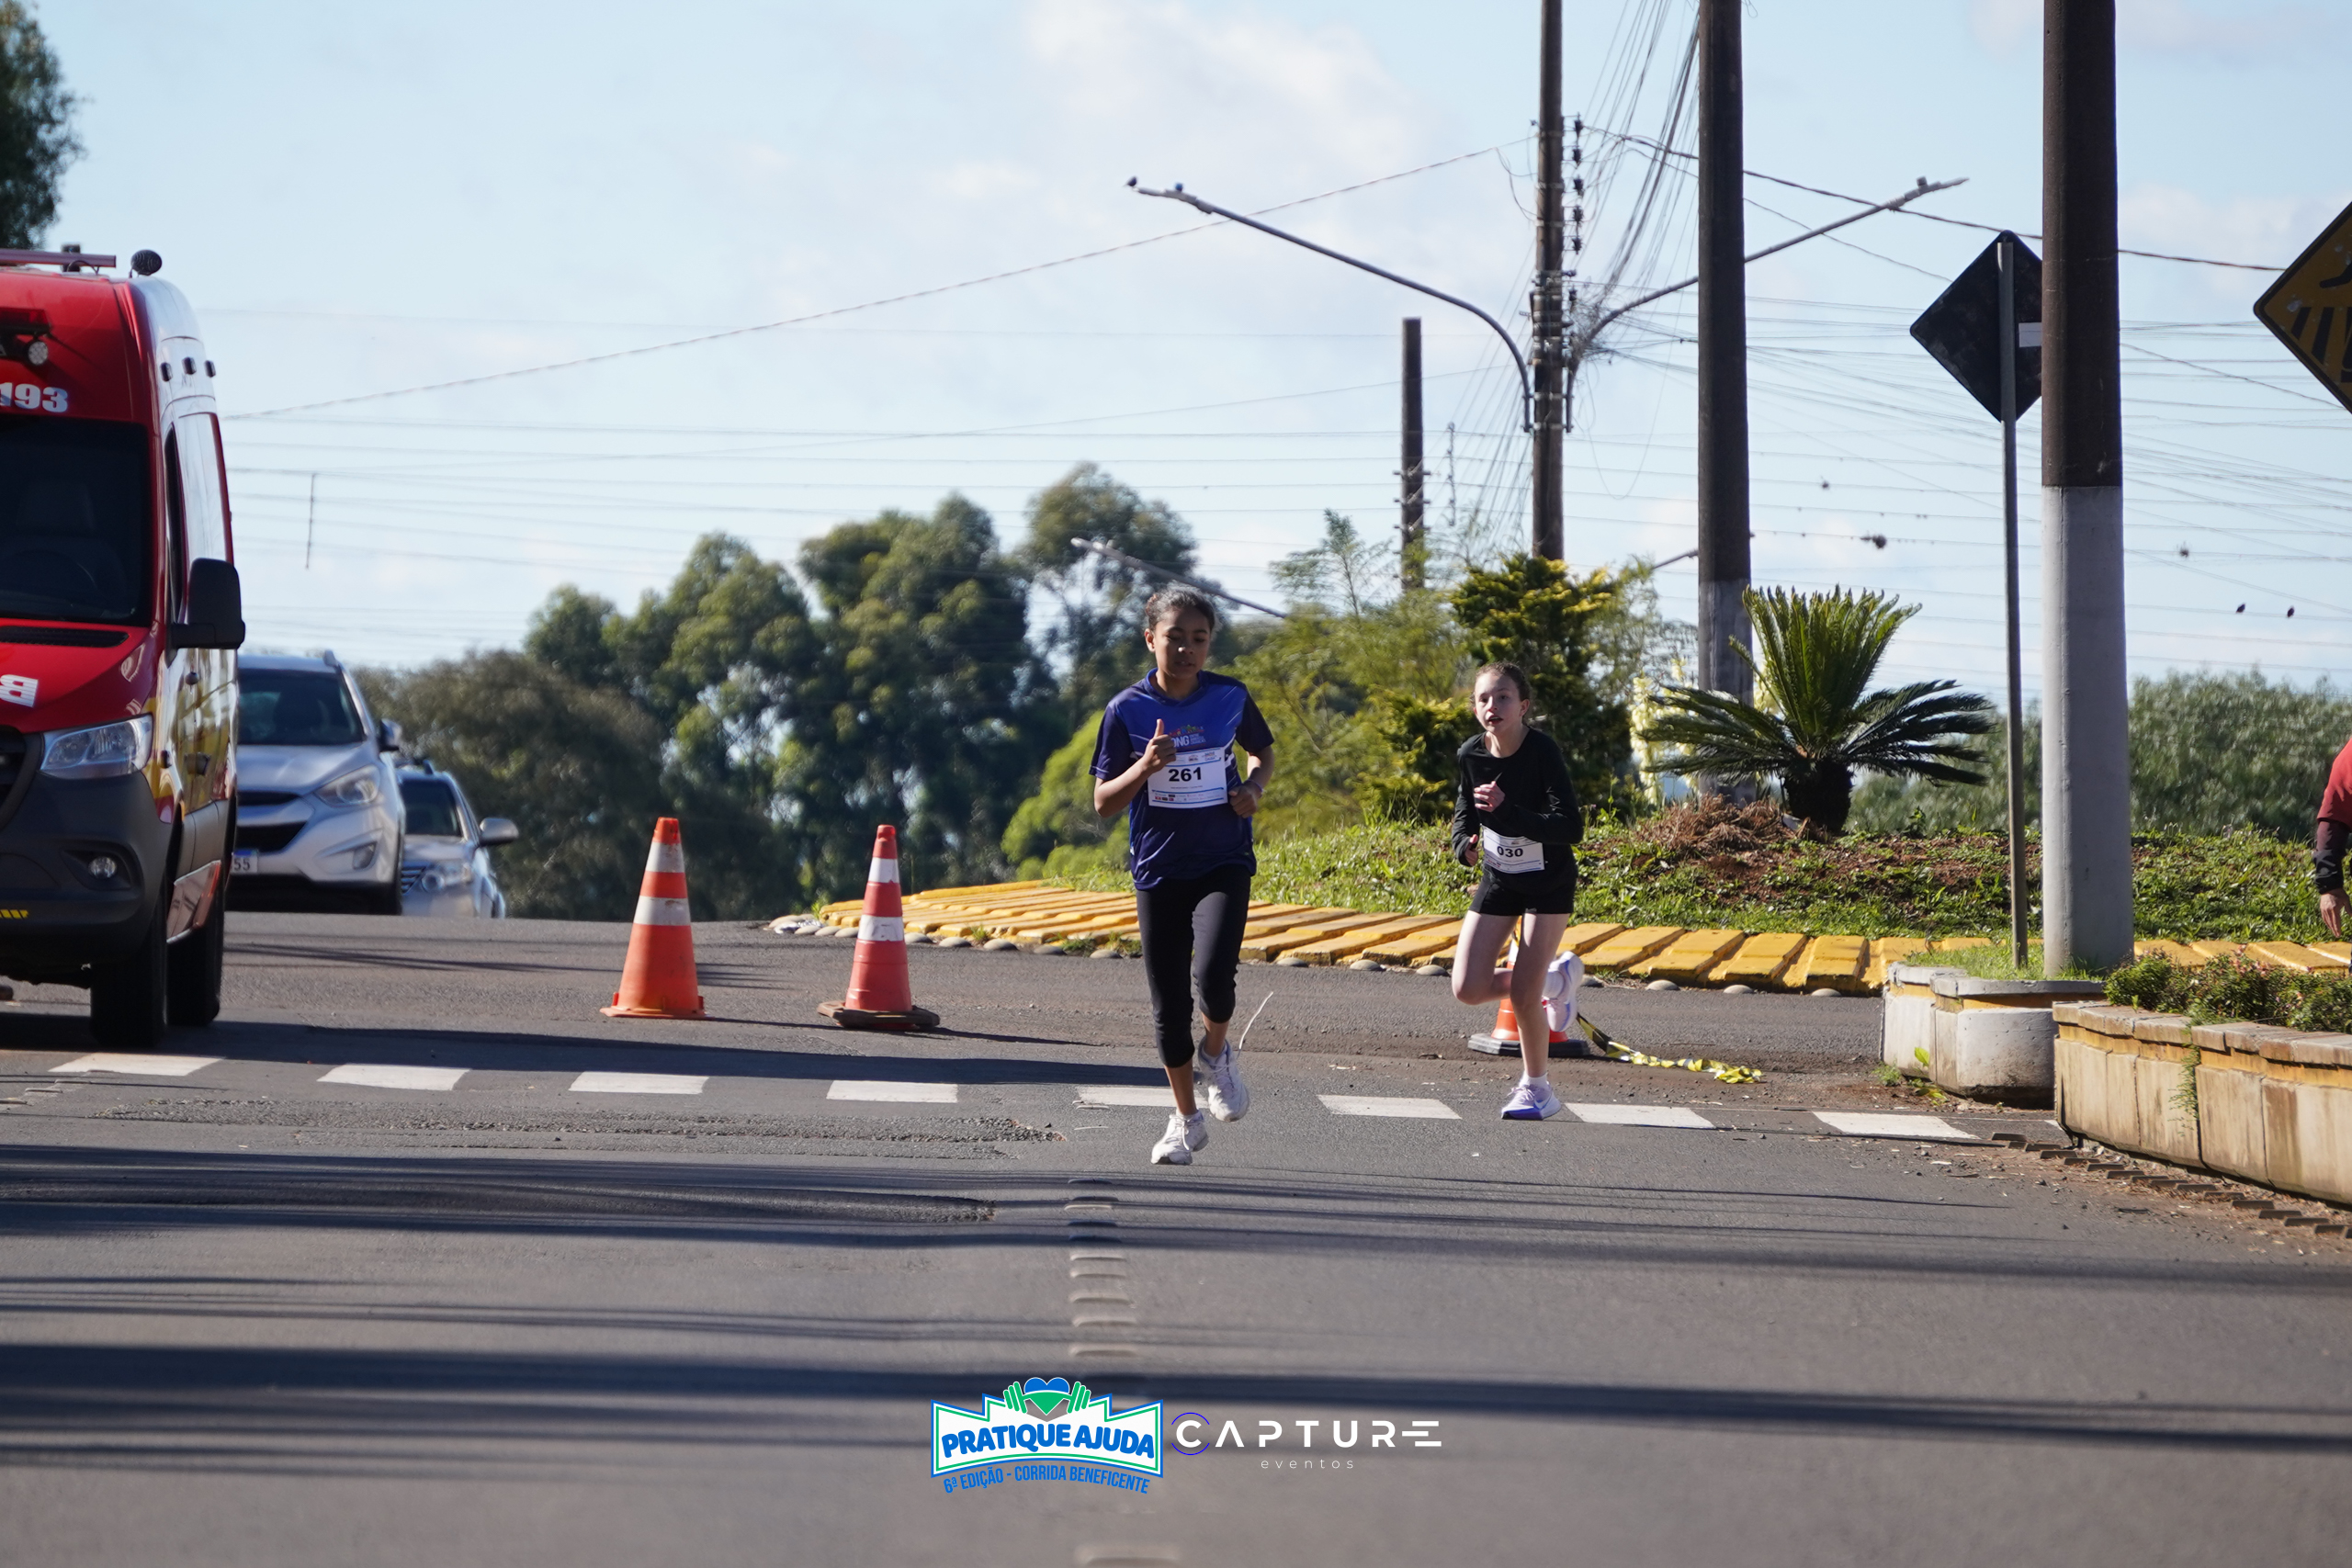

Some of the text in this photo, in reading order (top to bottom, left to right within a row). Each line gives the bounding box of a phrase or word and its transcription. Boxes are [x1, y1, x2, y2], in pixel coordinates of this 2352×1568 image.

[0, 382, 68, 412] 193
[1169, 766, 1202, 782] 261
[1497, 845, 1524, 858] 030
